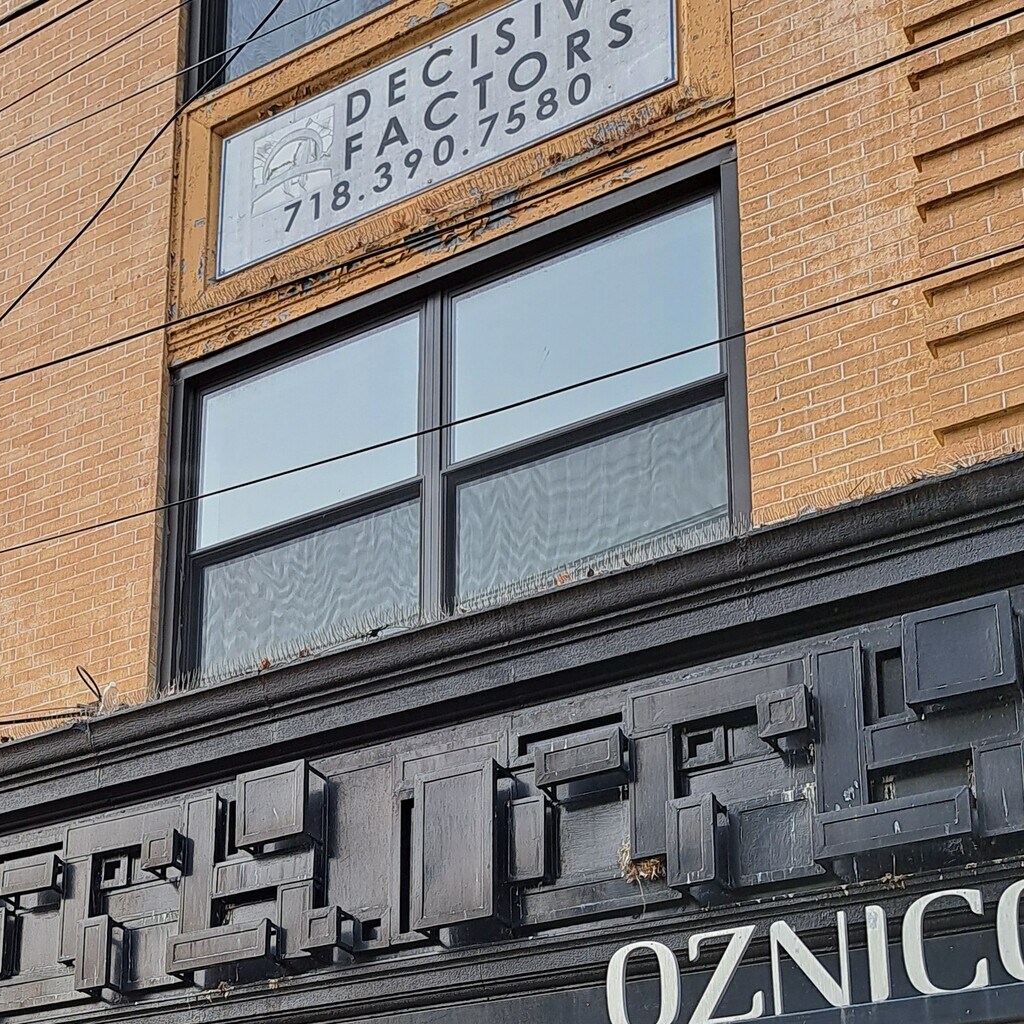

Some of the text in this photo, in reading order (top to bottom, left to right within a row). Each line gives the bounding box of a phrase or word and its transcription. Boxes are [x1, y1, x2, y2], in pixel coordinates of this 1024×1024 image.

[344, 8, 634, 171] FACTORS
[347, 0, 619, 127] DECISIV
[283, 72, 592, 233] 718.390.7580
